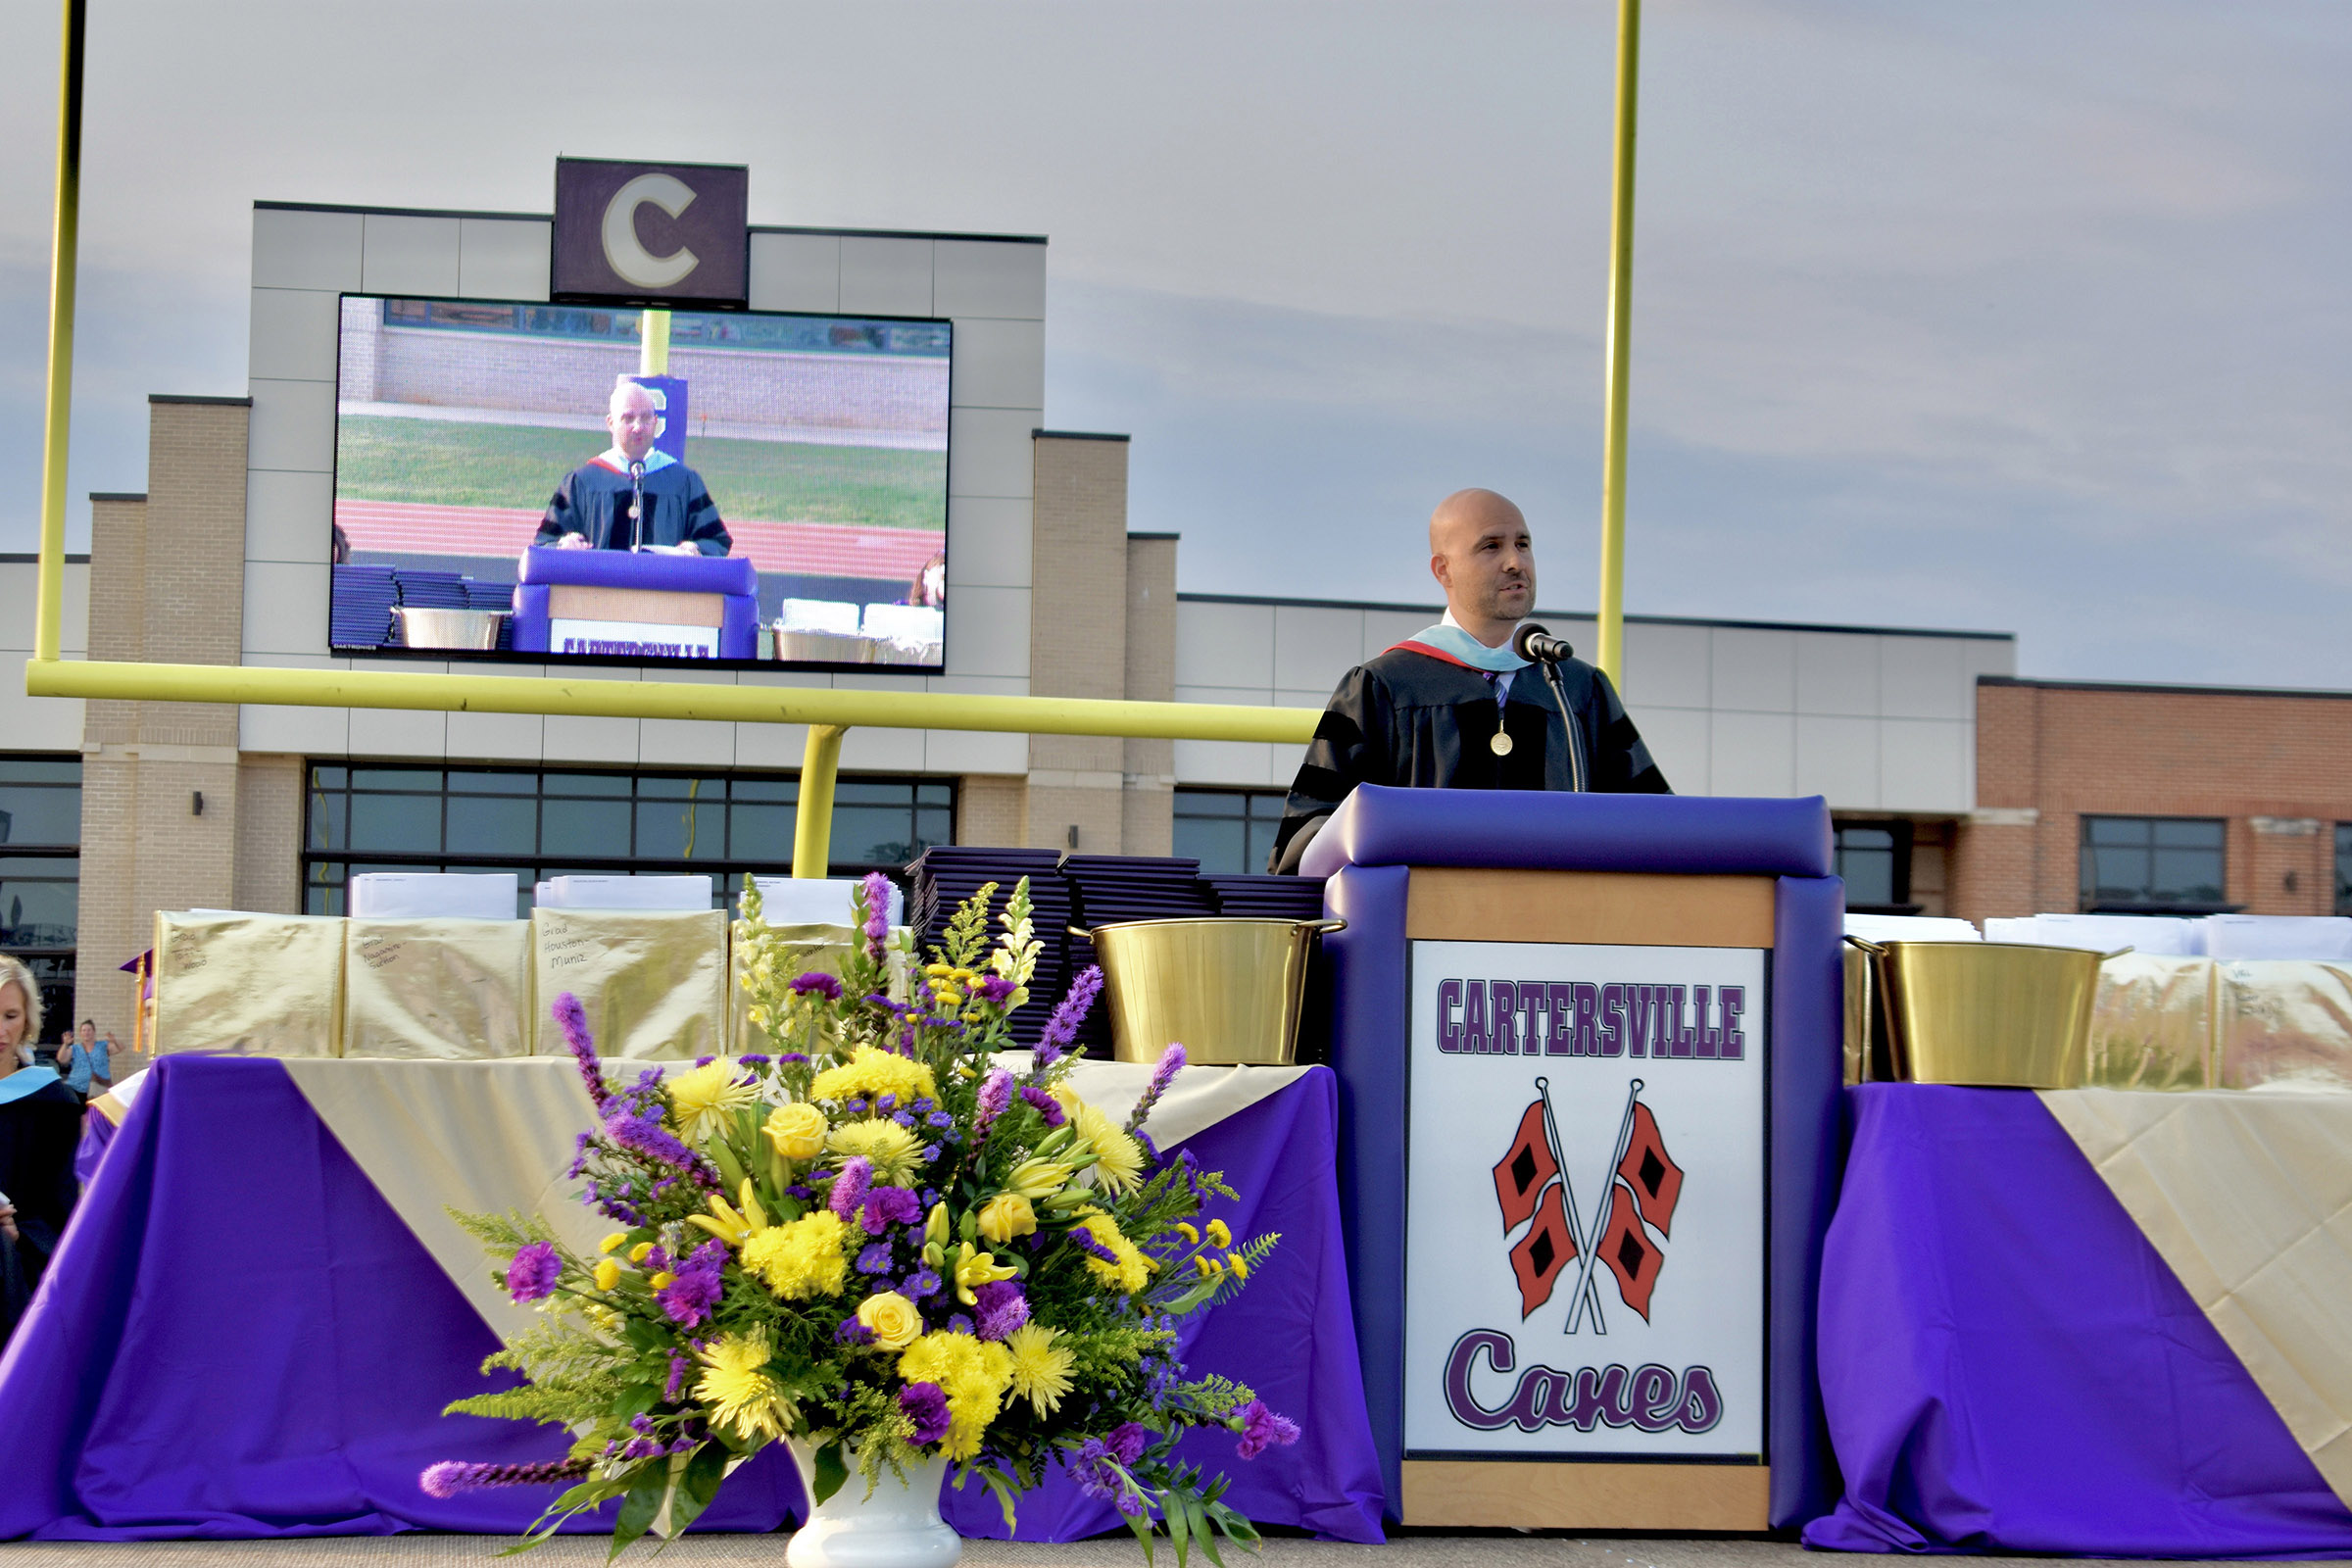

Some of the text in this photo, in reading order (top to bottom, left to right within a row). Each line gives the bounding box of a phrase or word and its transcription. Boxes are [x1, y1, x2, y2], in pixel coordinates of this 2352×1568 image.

[601, 172, 700, 289] C
[542, 921, 568, 937] Grad
[551, 953, 588, 968] Muniz
[1437, 978, 1745, 1061] CARTERSVILLE
[1444, 1328, 1724, 1434] Canes
